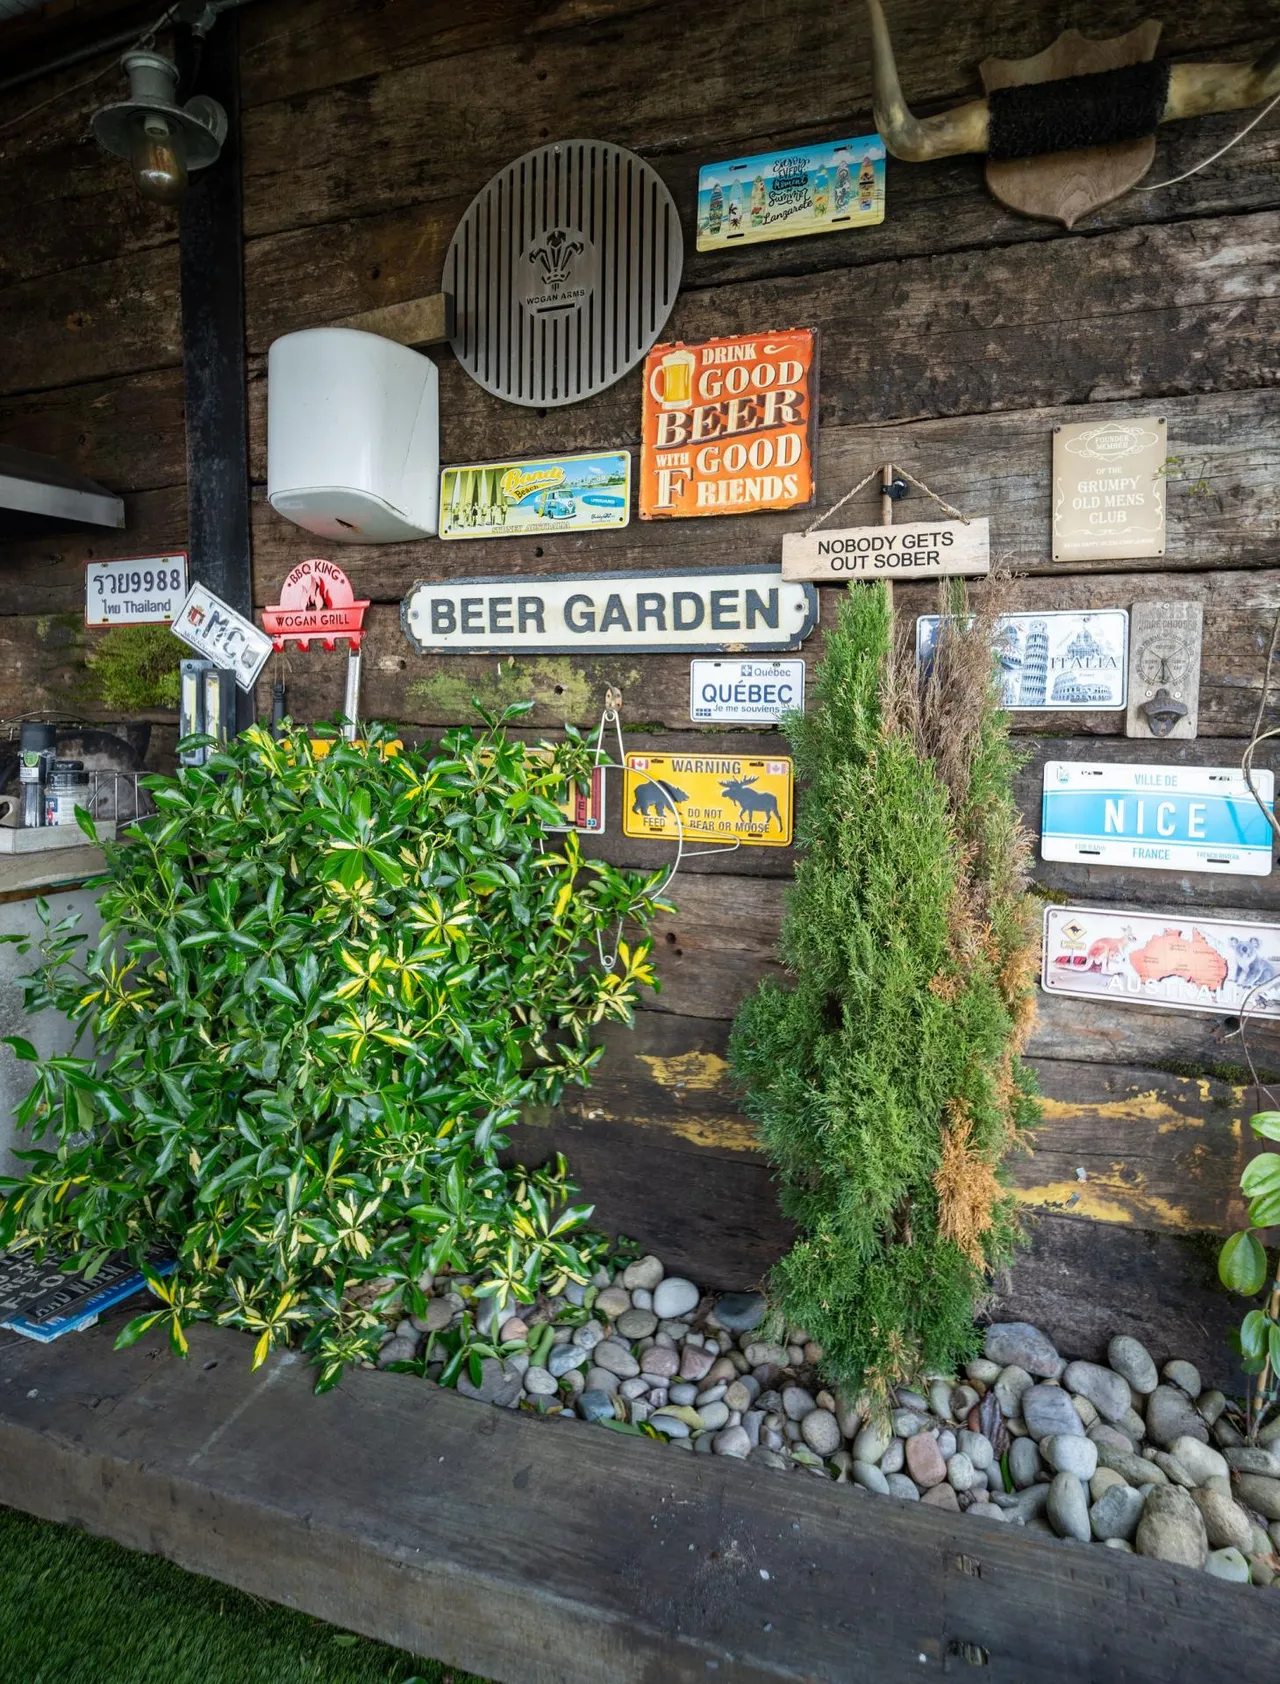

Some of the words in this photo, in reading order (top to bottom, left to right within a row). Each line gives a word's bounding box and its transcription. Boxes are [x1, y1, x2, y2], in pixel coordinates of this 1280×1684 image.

[763, 200, 813, 225] Lanzarote
[526, 294, 558, 305] WOGAN
[560, 289, 585, 300] ARMS
[702, 343, 757, 366] DRINK
[698, 360, 804, 400] GOOD
[653, 389, 803, 450] BEER
[656, 452, 690, 467] WITH
[696, 433, 802, 474] GOOD
[1096, 467, 1106, 475] OF
[515, 484, 541, 500] Beach
[1078, 475, 1141, 493] GRUMPY
[1072, 496, 1100, 510] OLD
[1104, 493, 1145, 508] MENS
[1090, 510, 1127, 525] CLUB
[525, 521, 571, 533] AUSTRALIA
[818, 535, 897, 554] NOBODY
[902, 531, 954, 549] GETS
[831, 555, 869, 570] OUT
[874, 550, 940, 568] SOBER
[289, 563, 311, 585] BBQ
[314, 561, 340, 580] KING
[93, 569, 181, 595] รวย9988
[102, 598, 121, 614] ไทย
[123, 599, 171, 614] Thailand
[430, 596, 546, 635] BEER
[564, 587, 780, 634] GARDEN
[275, 615, 317, 627] WOGAN
[320, 613, 349, 626] GRILL
[1051, 656, 1117, 669] ITALIA
[754, 666, 791, 677] Québec
[702, 680, 793, 703] QUÉBEC
[713, 704, 724, 712] Je
[741, 704, 780, 713] souviens
[671, 759, 741, 774] WARNING
[1134, 774, 1163, 786] VILLE
[1164, 775, 1178, 787] DE
[688, 808, 700, 818] DO
[704, 809, 722, 819] NOT
[1104, 799, 1206, 838] NICE
[643, 817, 666, 827] FEED
[690, 820, 715, 831] BEAR
[718, 821, 731, 832] OR
[735, 822, 770, 833] MOOSE
[1132, 847, 1170, 860] FRANCE
